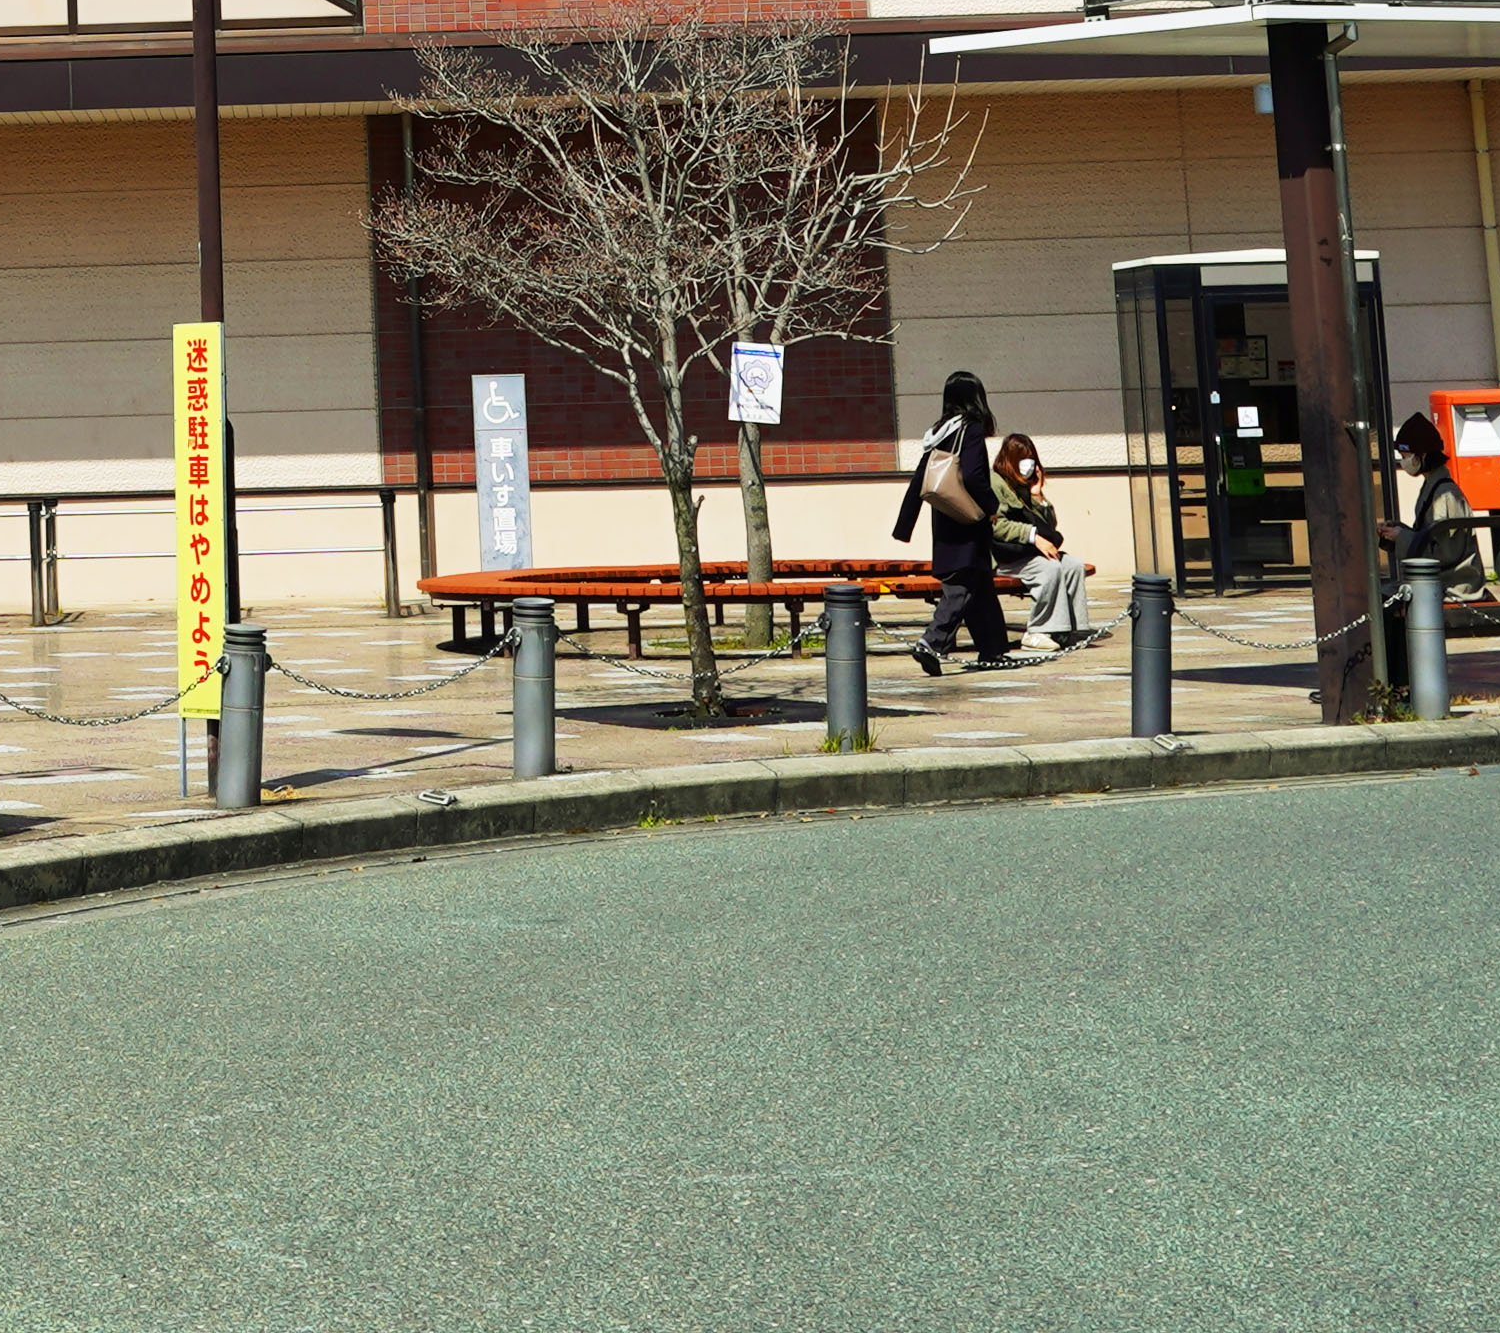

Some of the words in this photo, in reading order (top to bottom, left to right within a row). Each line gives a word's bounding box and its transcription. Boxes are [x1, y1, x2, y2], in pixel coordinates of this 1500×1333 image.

[186, 338, 211, 684] 迷惑駐車はやめよう
[489, 436, 518, 555] 車いす置場
